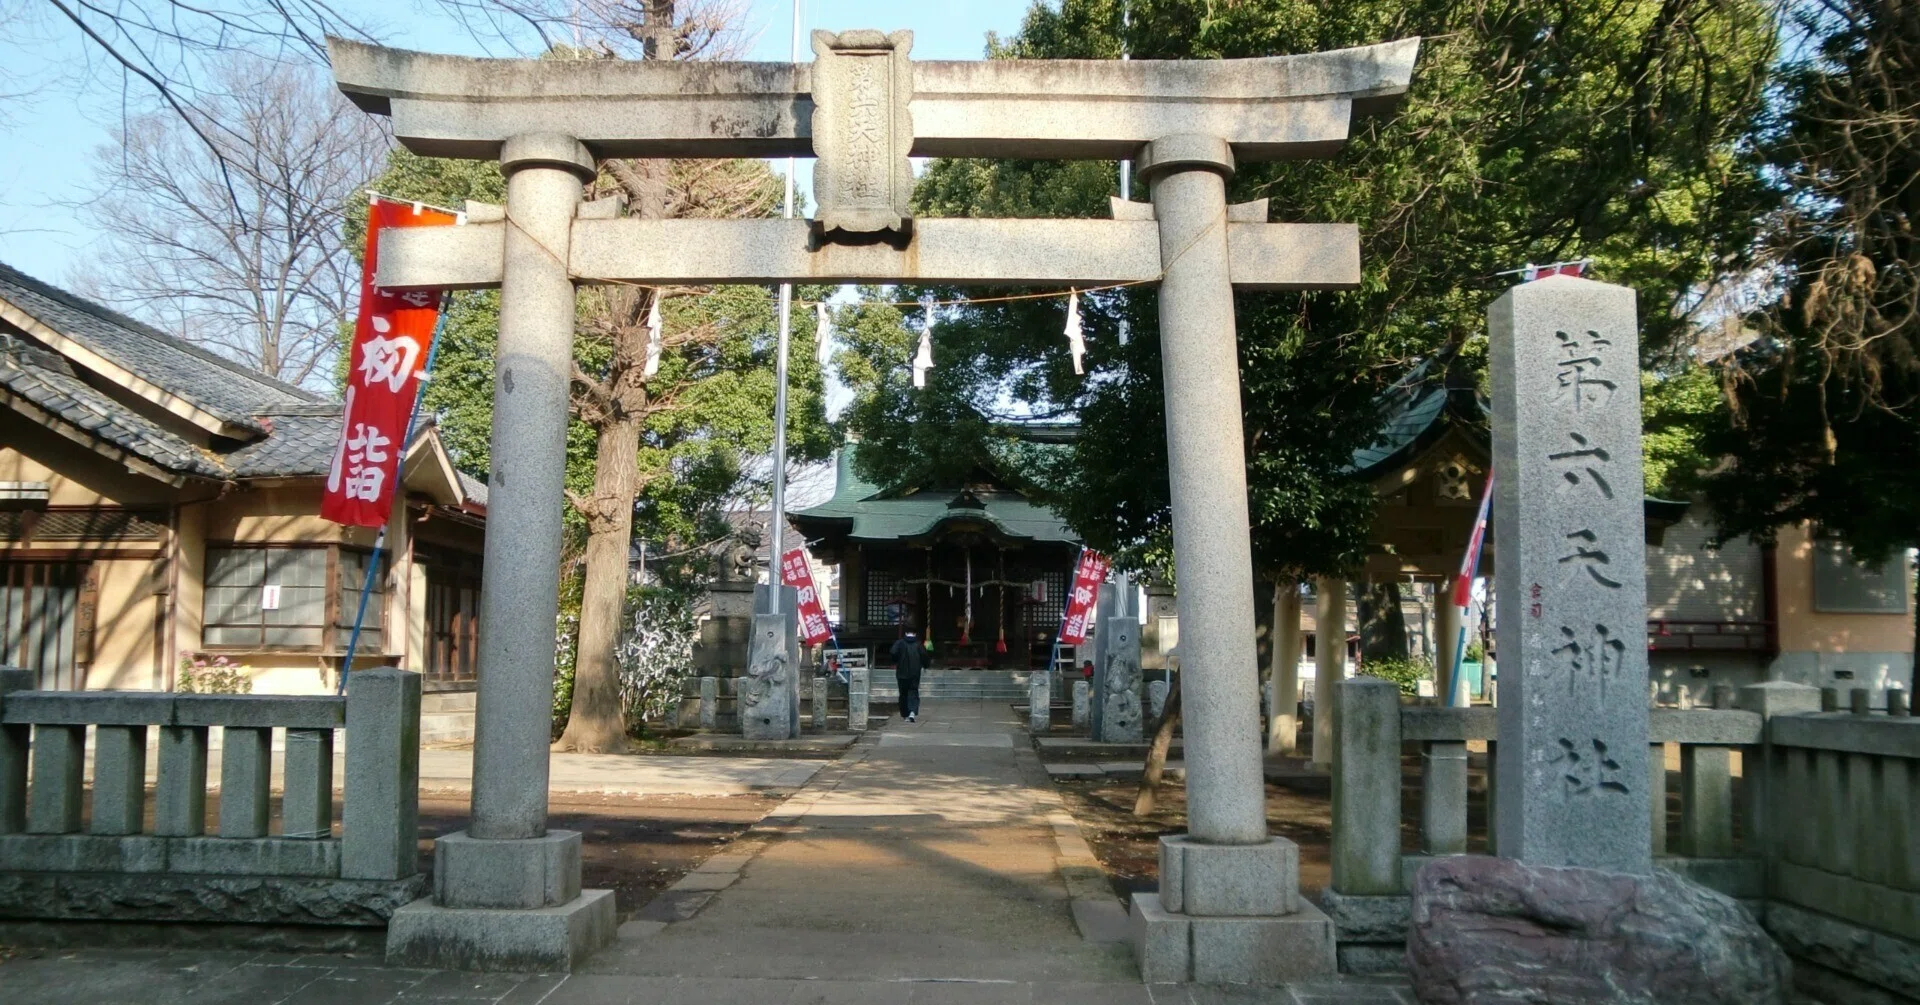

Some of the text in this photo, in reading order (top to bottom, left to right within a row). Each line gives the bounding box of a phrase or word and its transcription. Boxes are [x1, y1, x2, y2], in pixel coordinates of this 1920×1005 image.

[345, 316, 420, 503] 初詣
[797, 585, 826, 638] 初詣
[1548, 330, 1630, 796] 第六天神社
